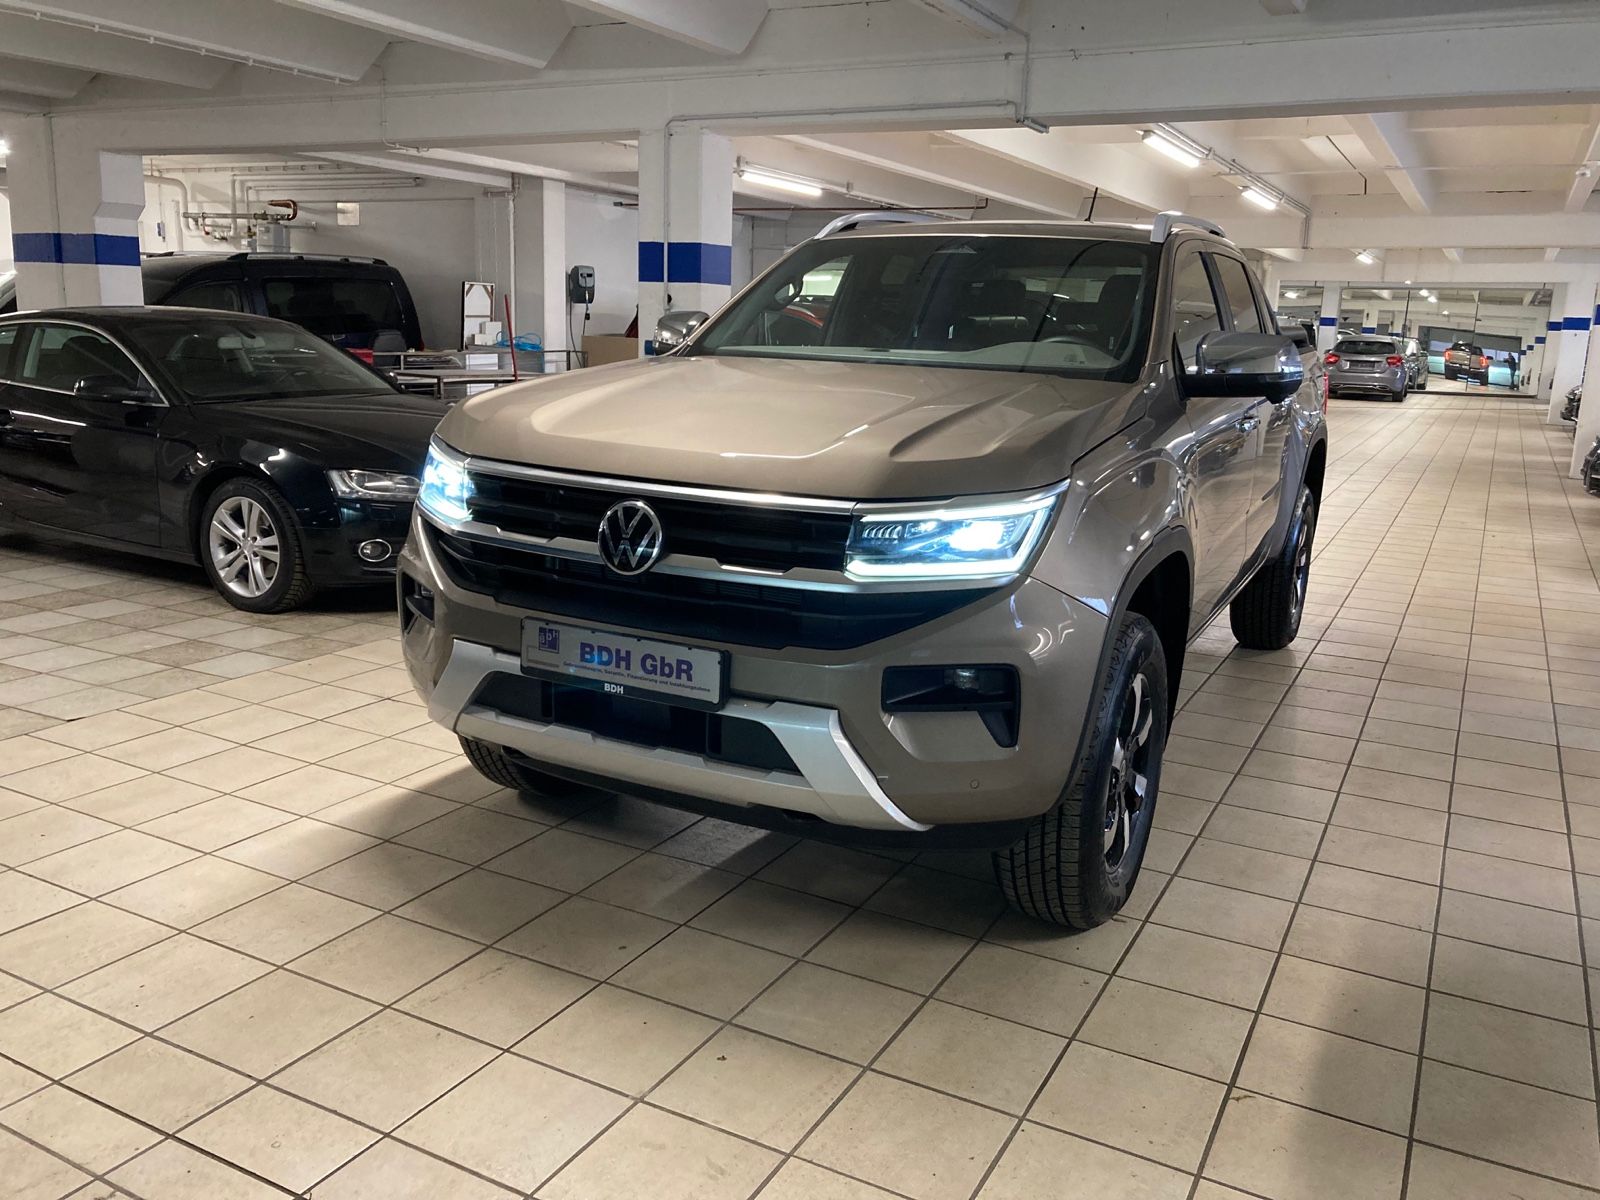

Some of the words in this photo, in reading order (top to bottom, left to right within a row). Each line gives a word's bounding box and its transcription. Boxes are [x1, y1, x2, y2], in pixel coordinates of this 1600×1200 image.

[579, 642, 631, 671] BDH
[640, 653, 693, 682] GbR
[604, 683, 624, 695] BDH
